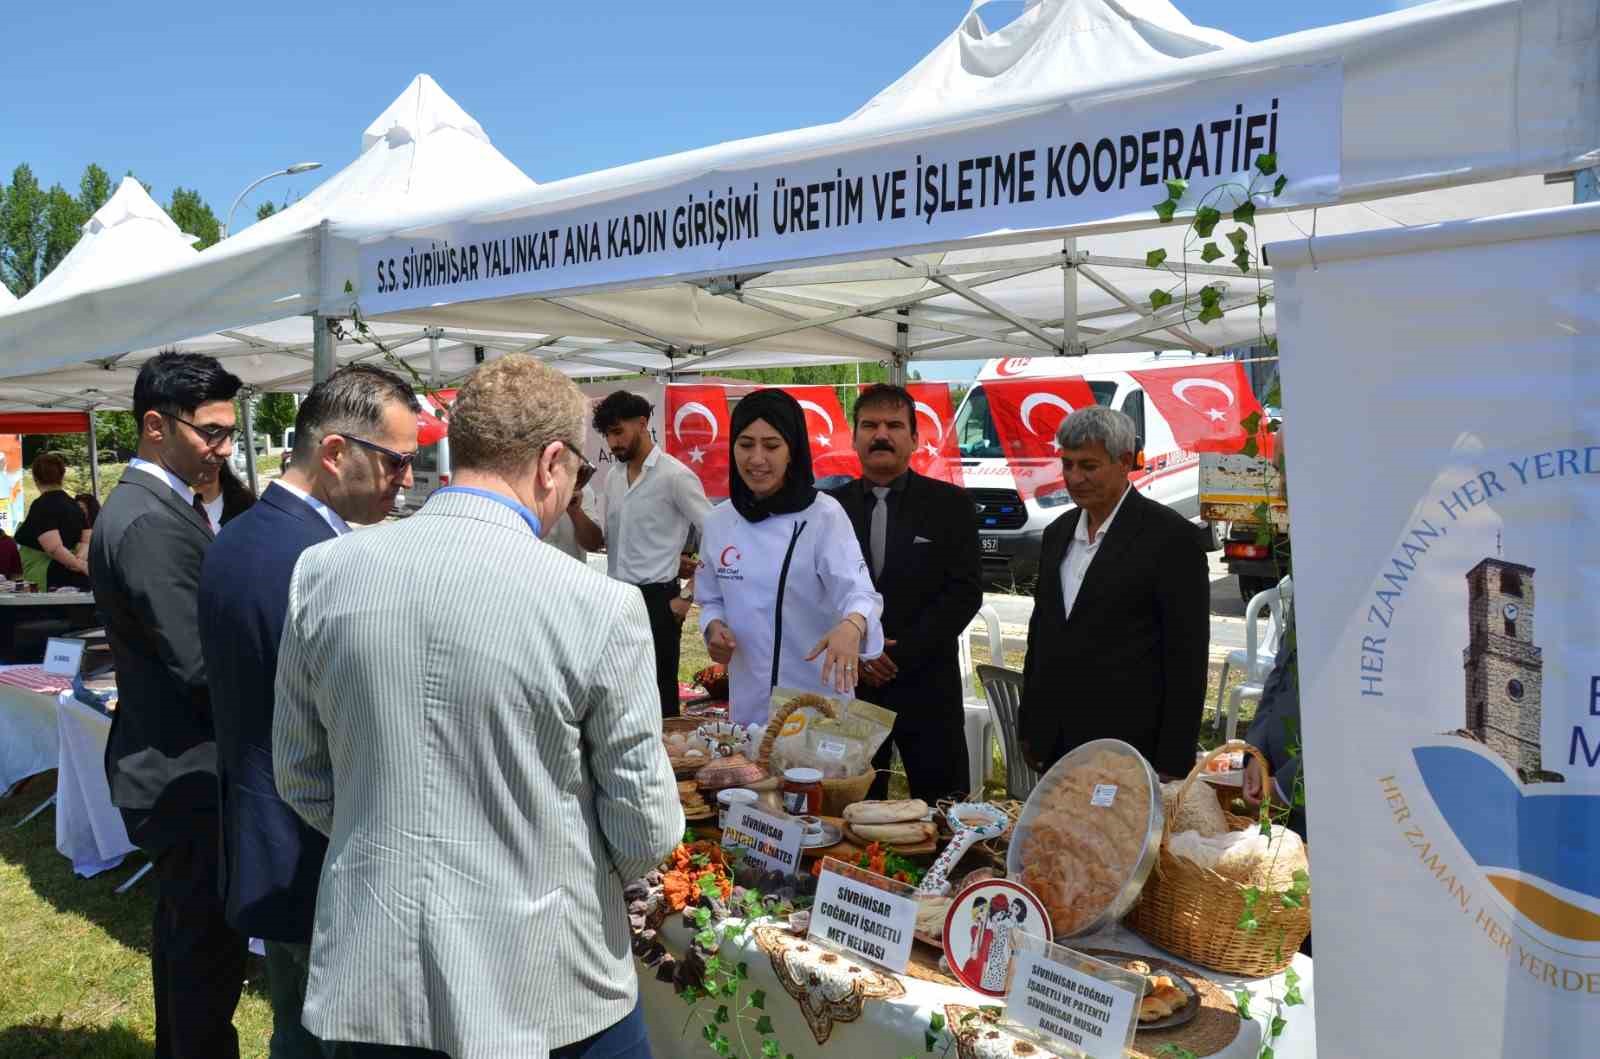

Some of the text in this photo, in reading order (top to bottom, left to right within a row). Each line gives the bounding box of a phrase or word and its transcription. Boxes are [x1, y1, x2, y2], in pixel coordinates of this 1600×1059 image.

[377, 97, 1279, 293] S.S. SİVRİHİSAR YALINKAT ANA KADIN GİRİŞİMİ ÜRETİM VE İŞLETME KOOPERATİFİ
[1439, 470, 1506, 520] HER
[1368, 519, 1447, 629] ZAMAN,
[1361, 633, 1387, 697] HER
[1377, 775, 1411, 824] HER
[1475, 908, 1513, 958] HER
[820, 902, 902, 944] COĞRAFİ İŞARETLİ
[837, 886, 892, 918] SİVRİHİSAR
[827, 925, 847, 945] MET
[1061, 992, 1073, 1008] VE
